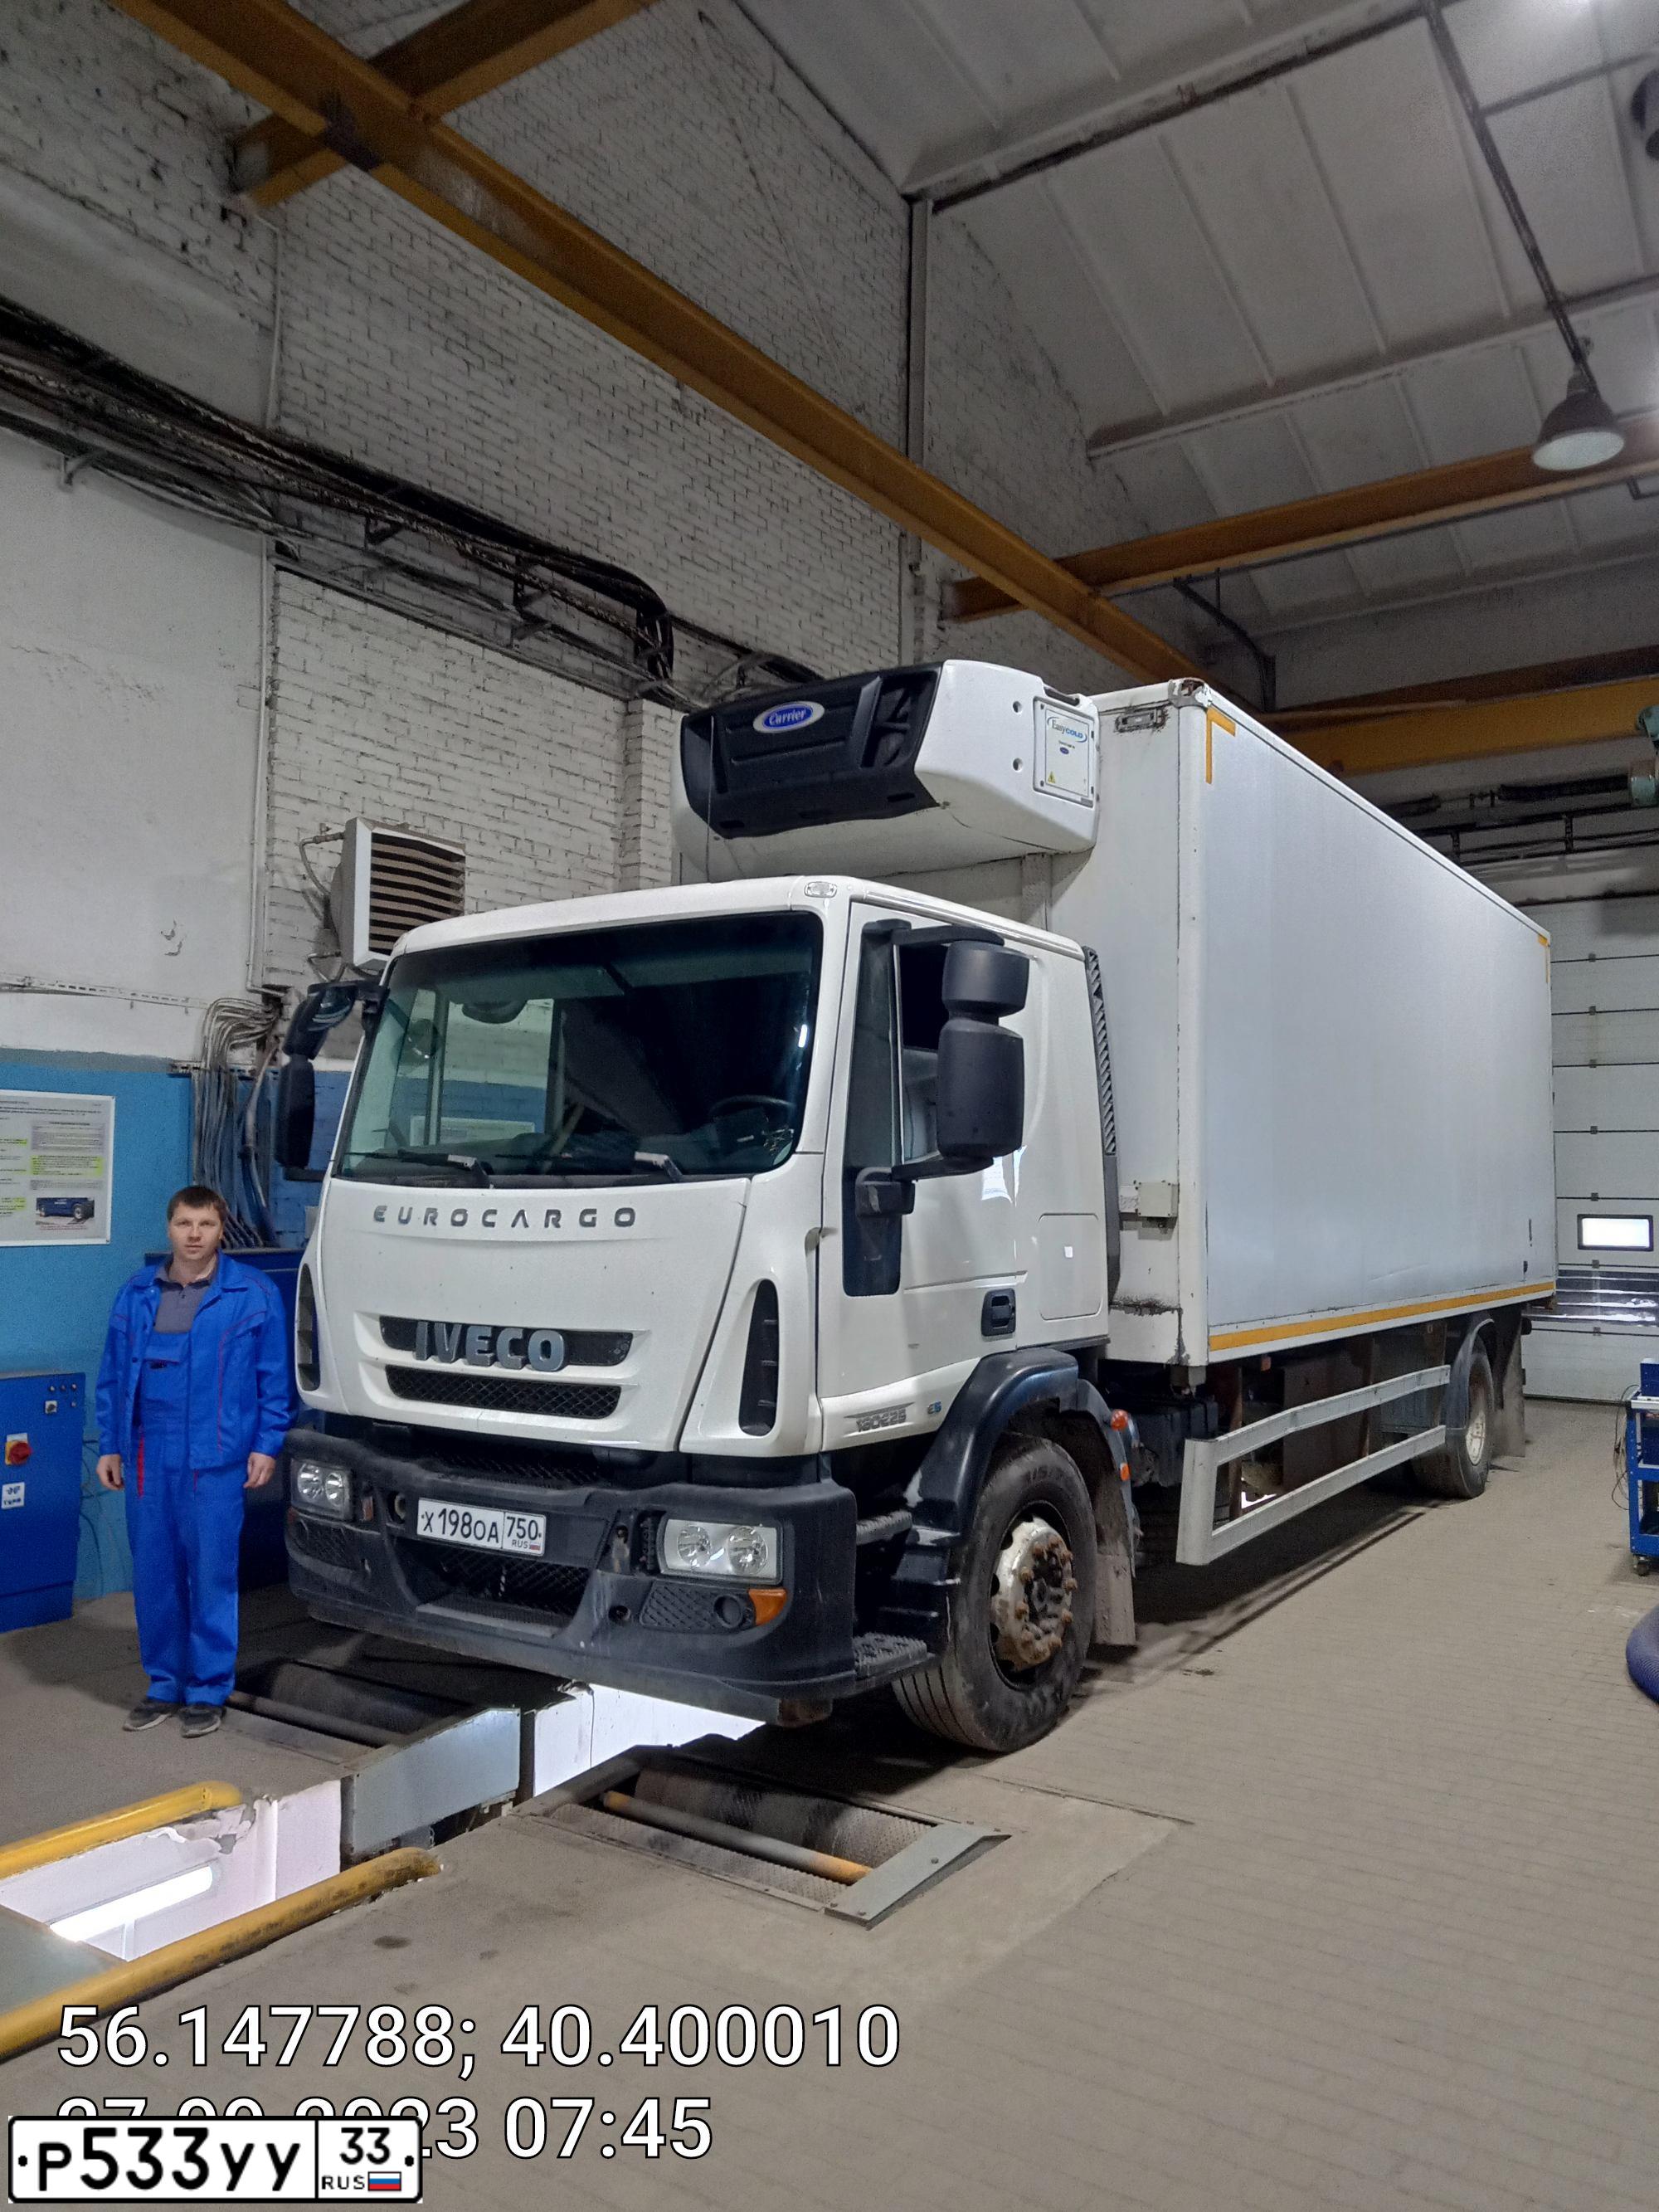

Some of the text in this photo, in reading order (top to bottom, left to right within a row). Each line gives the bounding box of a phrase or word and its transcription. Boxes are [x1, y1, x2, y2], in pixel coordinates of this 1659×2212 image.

[768, 709, 806, 726] Carrier
[373, 1205, 636, 1228] EUROCARGO
[415, 1321, 567, 1372] IVECO
[506, 1516, 539, 1541] 750
[511, 1539, 529, 1550] RUS
